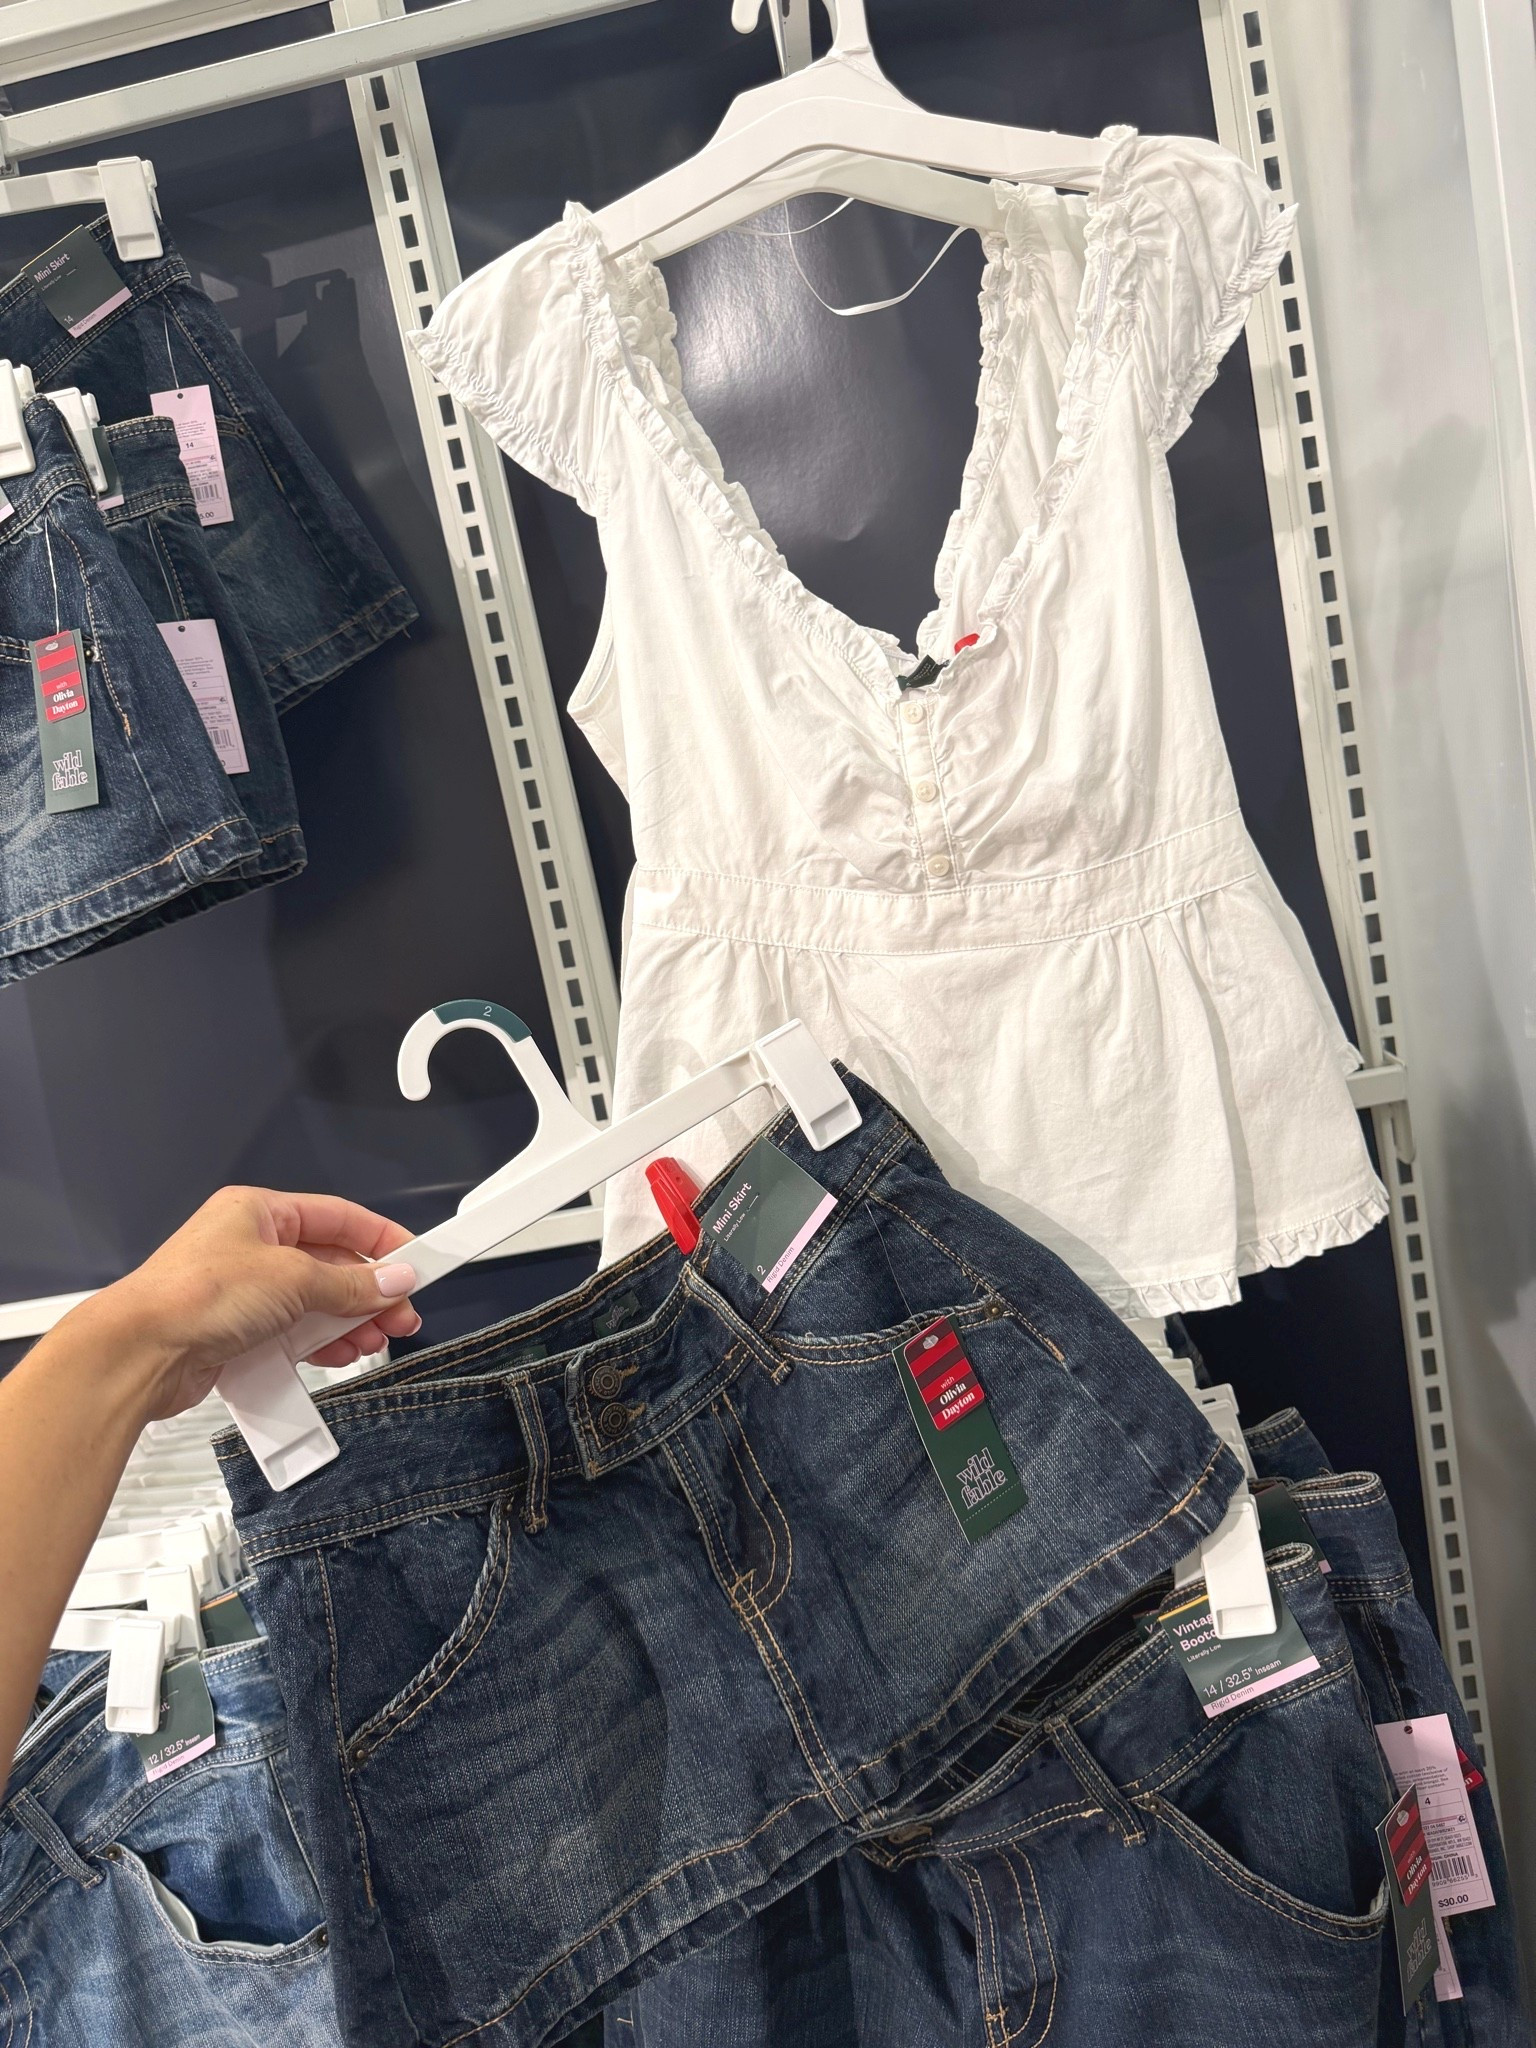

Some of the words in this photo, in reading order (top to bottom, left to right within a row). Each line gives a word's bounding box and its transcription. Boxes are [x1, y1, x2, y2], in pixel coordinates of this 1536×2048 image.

[34, 266, 52, 283] Mini
[50, 253, 70, 271] Skirt
[64, 315, 74, 324] 14
[53, 689, 74, 703] Olivia
[56, 681, 68, 690] with
[52, 700, 78, 715] Dayton
[52, 749, 83, 772] wild
[52, 768, 88, 791] fable
[483, 1006, 493, 1017] 2
[712, 1207, 734, 1234] Mini
[728, 1182, 752, 1211] Skirt
[723, 1219, 740, 1242] Literally
[736, 1212, 746, 1223] Low
[757, 1264, 766, 1276] 2
[766, 1263, 781, 1283] Rigid
[777, 1246, 795, 1268] Denim
[939, 1382, 967, 1406] Olivia
[940, 1376, 955, 1389] with
[941, 1392, 976, 1421] Dayton
[956, 1446, 996, 1486] wild
[960, 1469, 1007, 1510] fable
[1172, 1613, 1214, 1638] Vintag
[1180, 1629, 1217, 1652] Bootc
[1186, 1647, 1211, 1663] Literally
[1209, 1643, 1221, 1654] Low
[1203, 1684, 1218, 1698] 14
[1225, 1667, 1253, 1688] 32.5"
[1254, 1659, 1282, 1676] Inseam
[1210, 1696, 1230, 1711] Rigid
[1230, 1686, 1255, 1702] Denim
[148, 1753, 160, 1765] 12
[164, 1739, 184, 1757] 32.5"
[184, 1734, 201, 1746] Inseam
[1425, 1797, 1431, 1805] 4
[1406, 1854, 1423, 1881] Olivia
[1407, 1863, 1428, 1895] Dayton
[1438, 1894, 1469, 1908] $30.00
[1406, 1917, 1427, 1959] wild
[1406, 1938, 1432, 1983] fable
